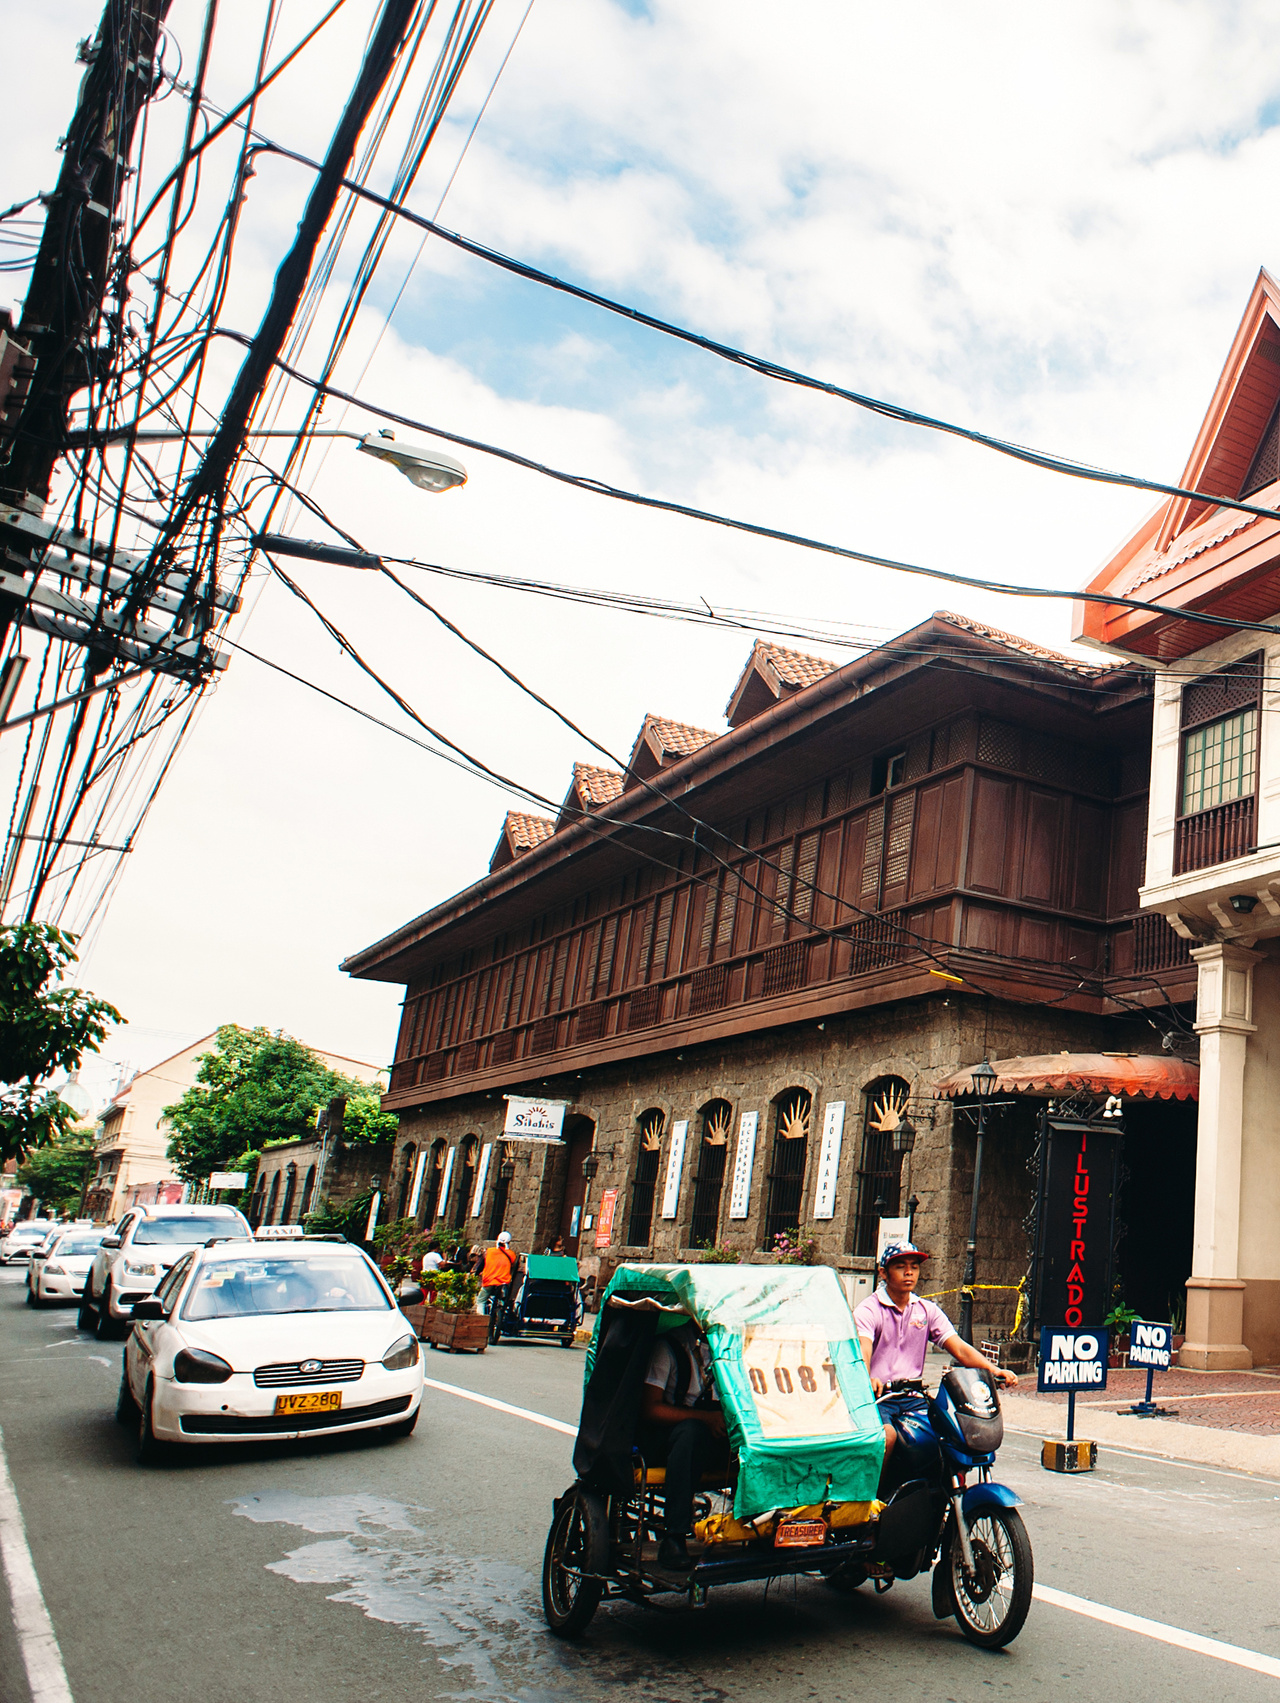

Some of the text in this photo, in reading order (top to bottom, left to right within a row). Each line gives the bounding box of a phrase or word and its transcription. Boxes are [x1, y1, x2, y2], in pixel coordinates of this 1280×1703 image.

[513, 1113, 556, 1129] Silahis
[733, 1121, 746, 1208] DECORATIVE
[738, 1121, 752, 1207] ACCESSORIES
[264, 1228, 297, 1236] TAXI
[1065, 1133, 1090, 1327] ILUSTRADO
[1050, 1334, 1099, 1361] NO
[1135, 1325, 1167, 1348] NO
[1129, 1345, 1171, 1366] PARKING
[749, 1364, 838, 1395] 0087
[1043, 1360, 1103, 1384] PARKING
[780, 1525, 824, 1537] TREASURER
